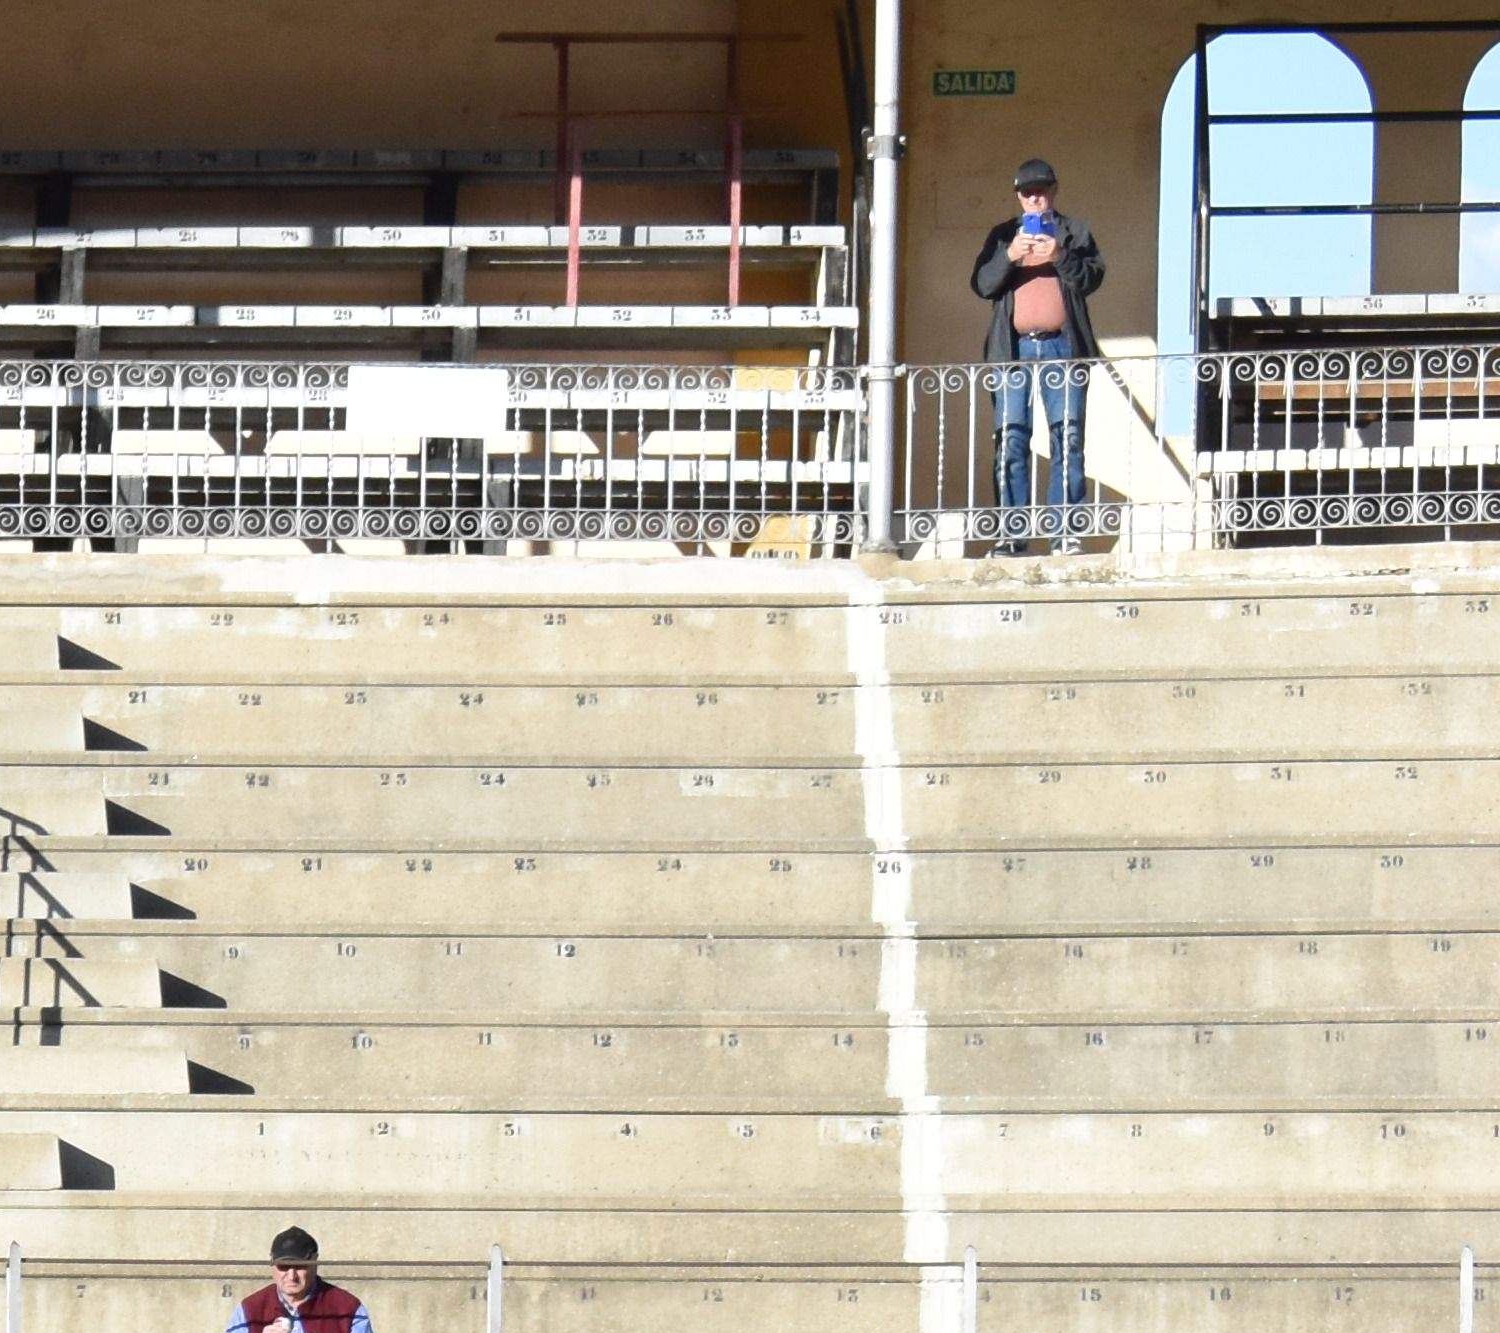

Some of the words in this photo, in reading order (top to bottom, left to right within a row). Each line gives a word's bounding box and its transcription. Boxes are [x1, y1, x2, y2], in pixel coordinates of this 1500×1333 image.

[938, 73, 1010, 91] SALIDA
[104, 612, 121, 625] 21
[210, 612, 234, 627] 22
[423, 612, 450, 626] 24
[651, 613, 674, 626] 26
[128, 690, 147, 705] 21
[238, 693, 262, 707] 22
[459, 693, 484, 708] 24
[695, 692, 719, 707] 26
[1038, 770, 1062, 784] 29
[184, 858, 209, 872] 20
[300, 857, 322, 872] 21
[405, 858, 433, 873] 22
[657, 858, 682, 872] 24
[876, 860, 902, 874] 26
[1126, 856, 1152, 872] 28
[1250, 854, 1274, 867] 29
[228, 947, 239, 959] 9
[337, 942, 357, 958] 10
[445, 942, 462, 956] 11
[557, 943, 576, 958] 12
[478, 1032, 492, 1046] 11
[593, 1033, 612, 1048] 12
[1085, 1032, 1104, 1046] 16
[1465, 1027, 1487, 1042] 19
[258, 1122, 266, 1136] 1
[998, 1122, 1009, 1137] 7
[1131, 1124, 1143, 1137] 8
[1263, 1122, 1275, 1137] 9
[1380, 1123, 1406, 1140] 10
[1210, 1286, 1232, 1301] 16
